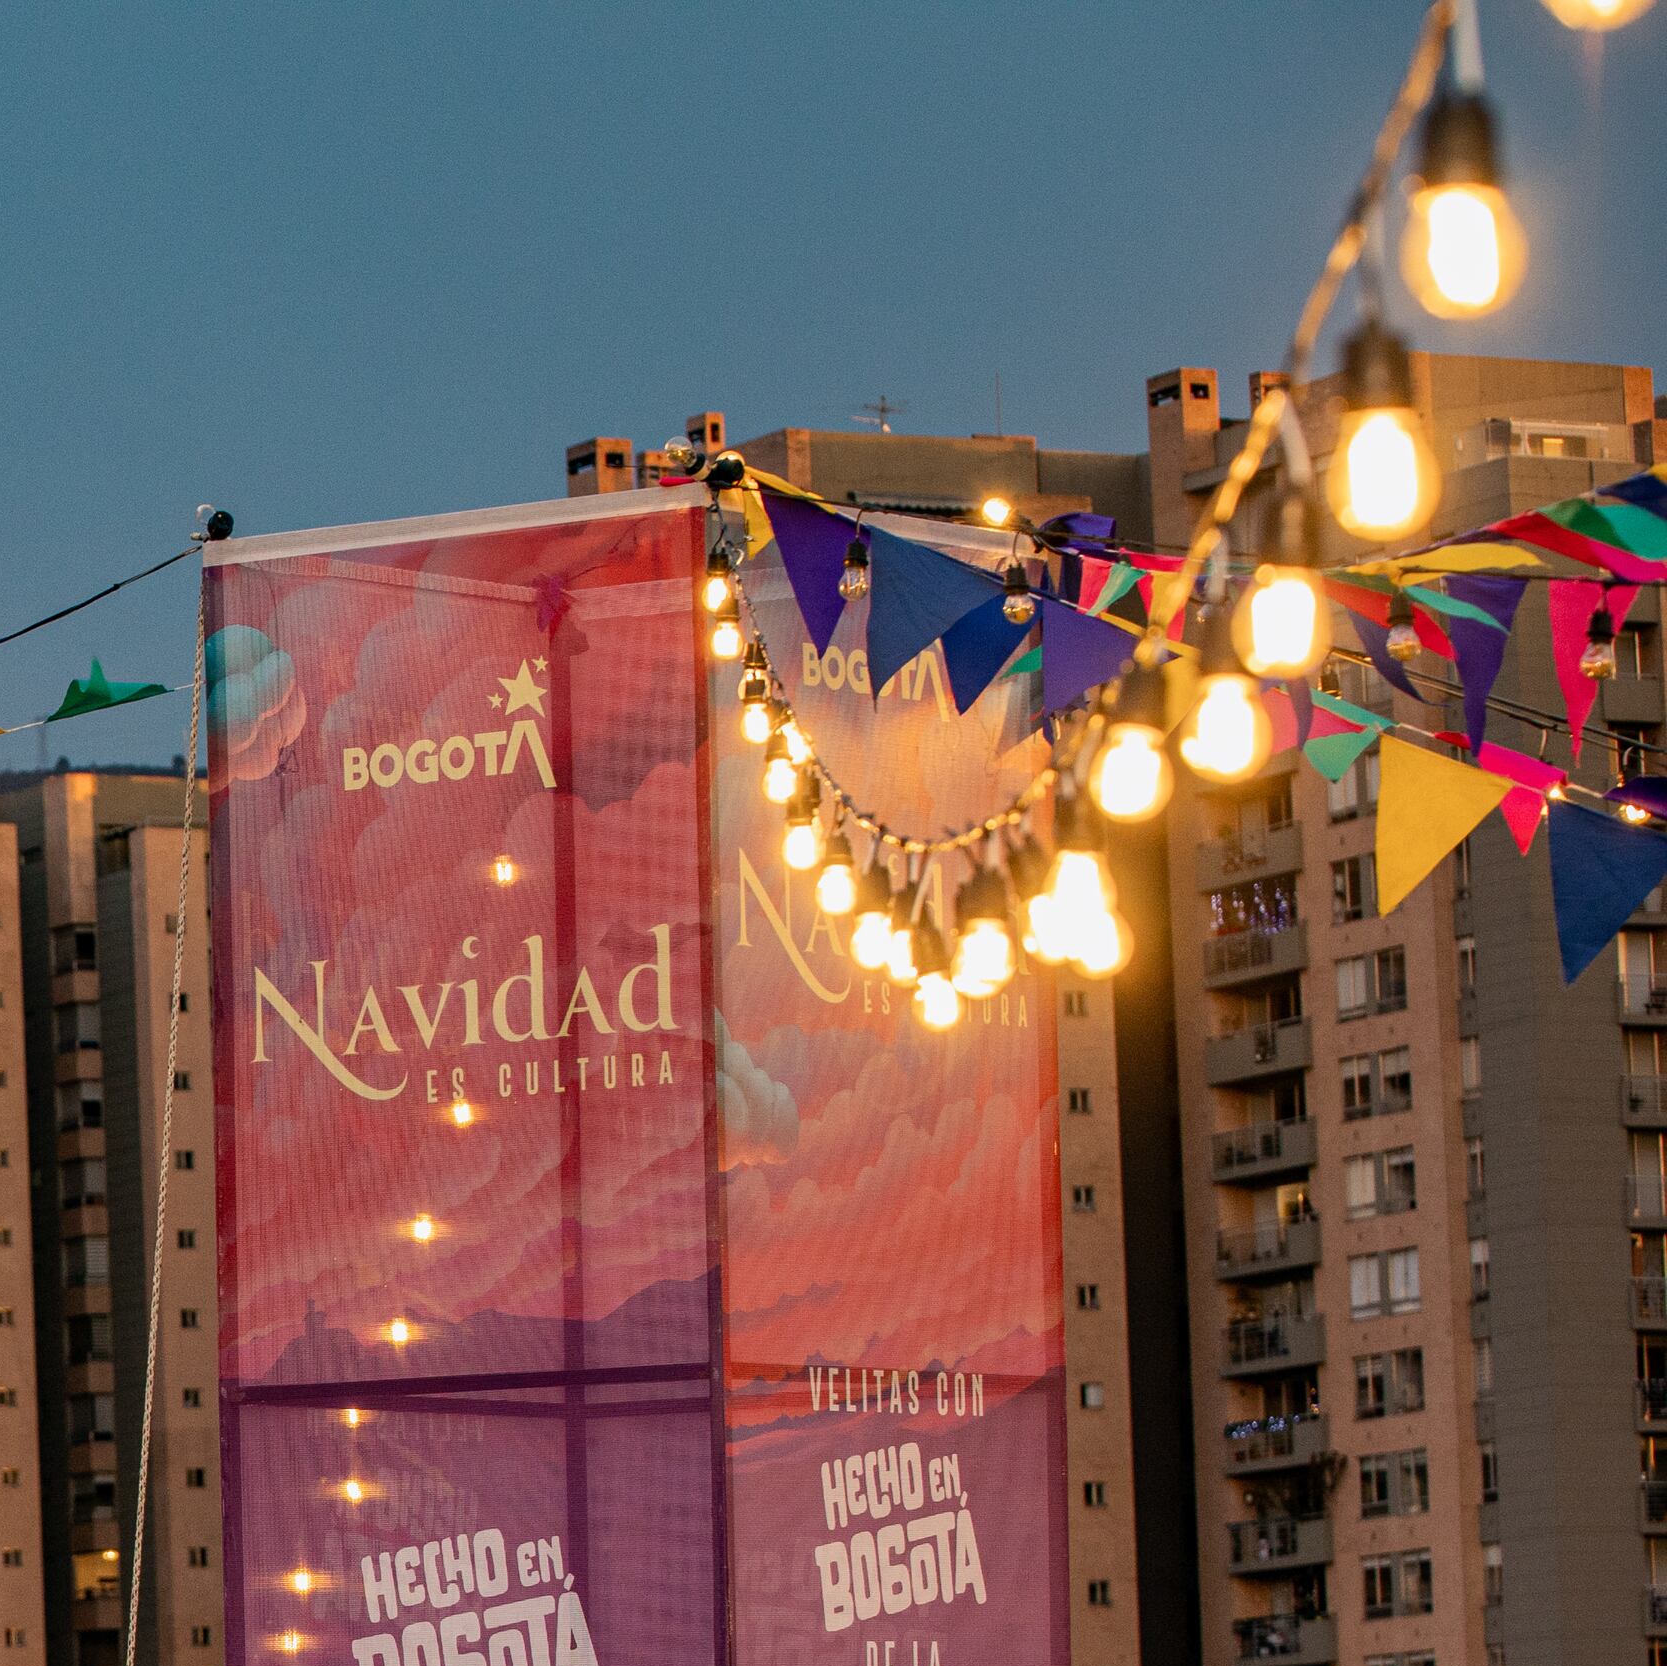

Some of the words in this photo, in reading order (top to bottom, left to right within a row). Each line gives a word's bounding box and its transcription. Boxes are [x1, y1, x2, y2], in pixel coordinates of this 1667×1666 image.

[863, 980, 891, 1015] ES
[427, 1067, 465, 1104] ES
[498, 1051, 674, 1097] CULTURA
[809, 1366, 919, 1415] VELITAS
[937, 1372, 984, 1417] CON
[820, 1442, 924, 1530] HECHO
[361, 1528, 509, 1623] HECHO
[814, 1490, 987, 1632] BOGOTÁ
